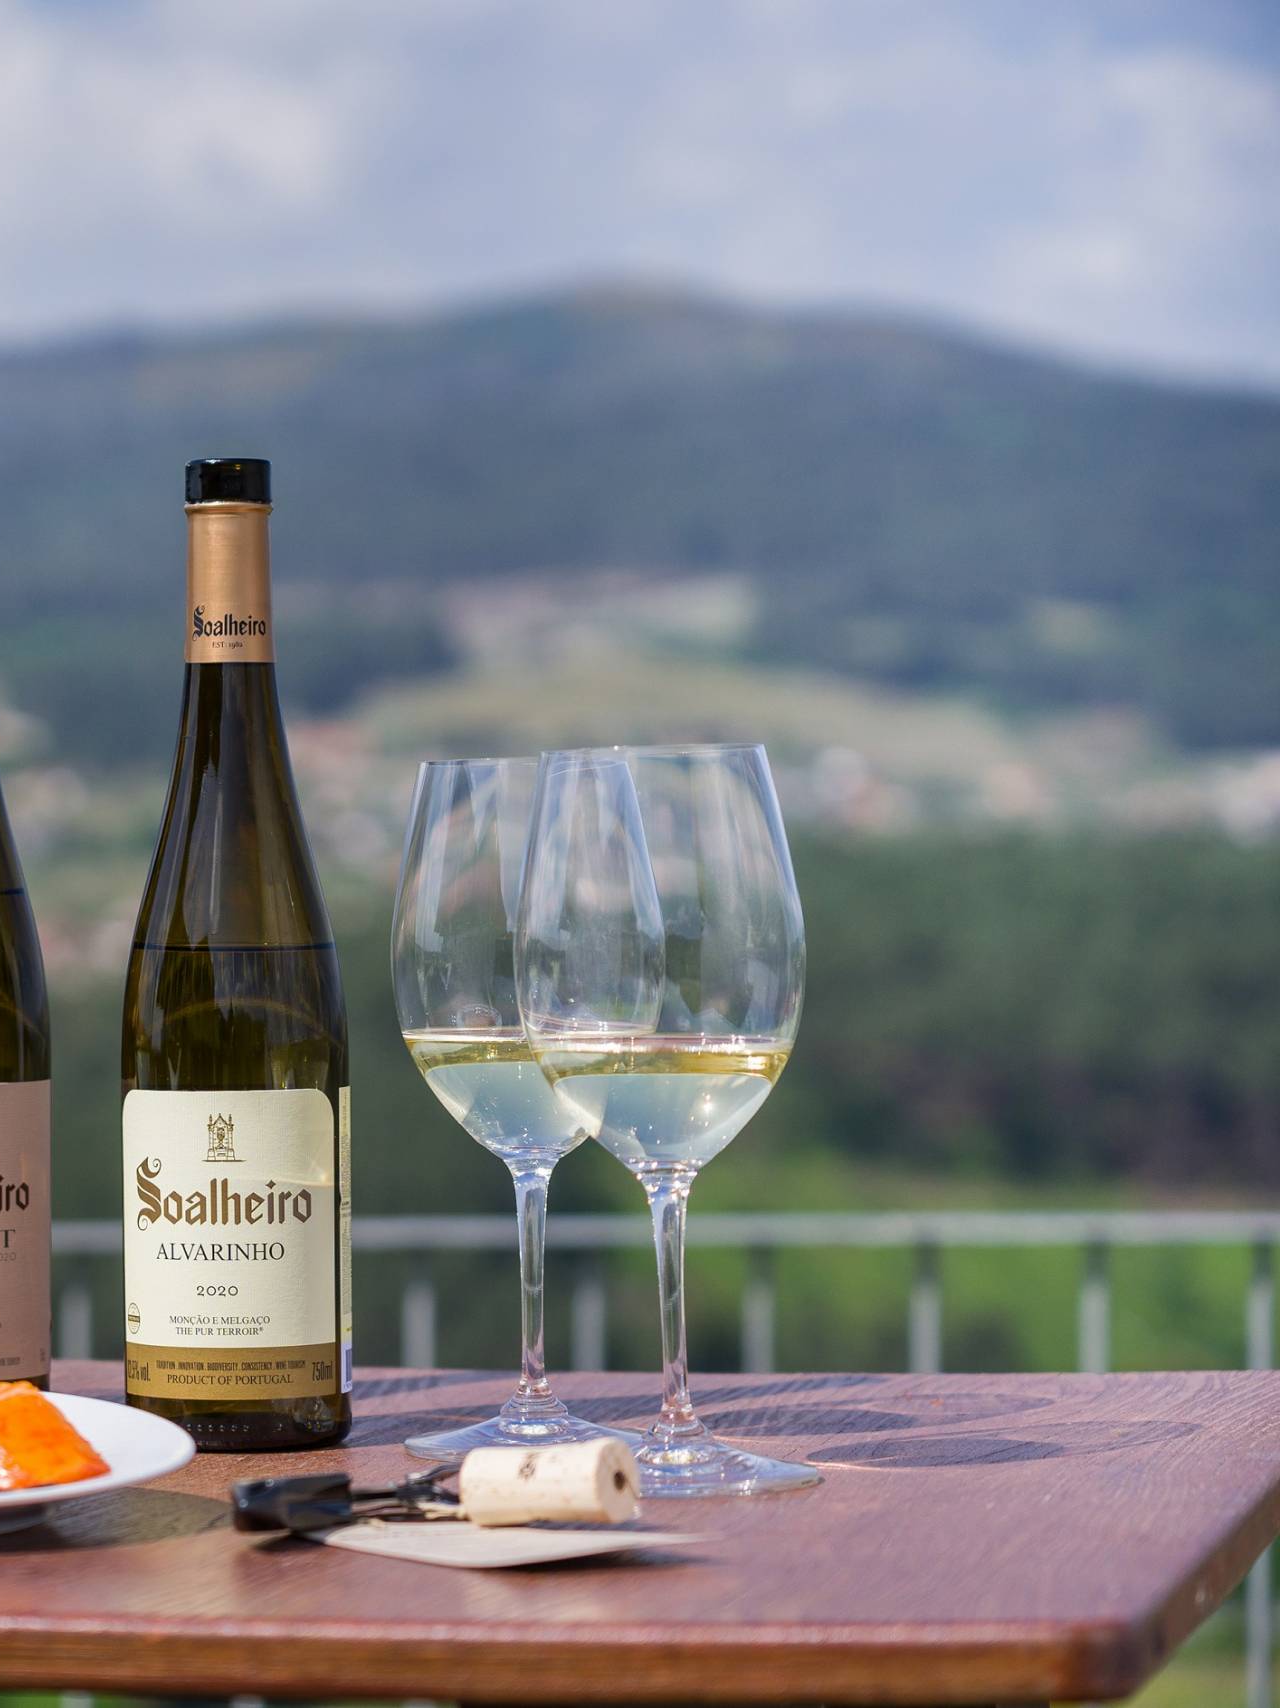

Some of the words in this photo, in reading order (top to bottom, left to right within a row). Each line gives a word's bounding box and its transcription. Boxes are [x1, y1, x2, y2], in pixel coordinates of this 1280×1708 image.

[192, 605, 266, 642] Soalheiro
[136, 1156, 313, 1231] Soalheiro
[155, 1241, 286, 1262] ALVARINHO
[195, 1285, 239, 1297] 2020
[169, 1314, 211, 1326] MONÇÃO
[212, 1316, 219, 1325] E
[221, 1315, 271, 1326] MELGAÇO
[175, 1326, 194, 1336] THE
[195, 1327, 214, 1336] PUR
[167, 1373, 216, 1385] PRODUCT
[217, 1375, 233, 1386] OF
[235, 1374, 295, 1386] PORTUGAL
